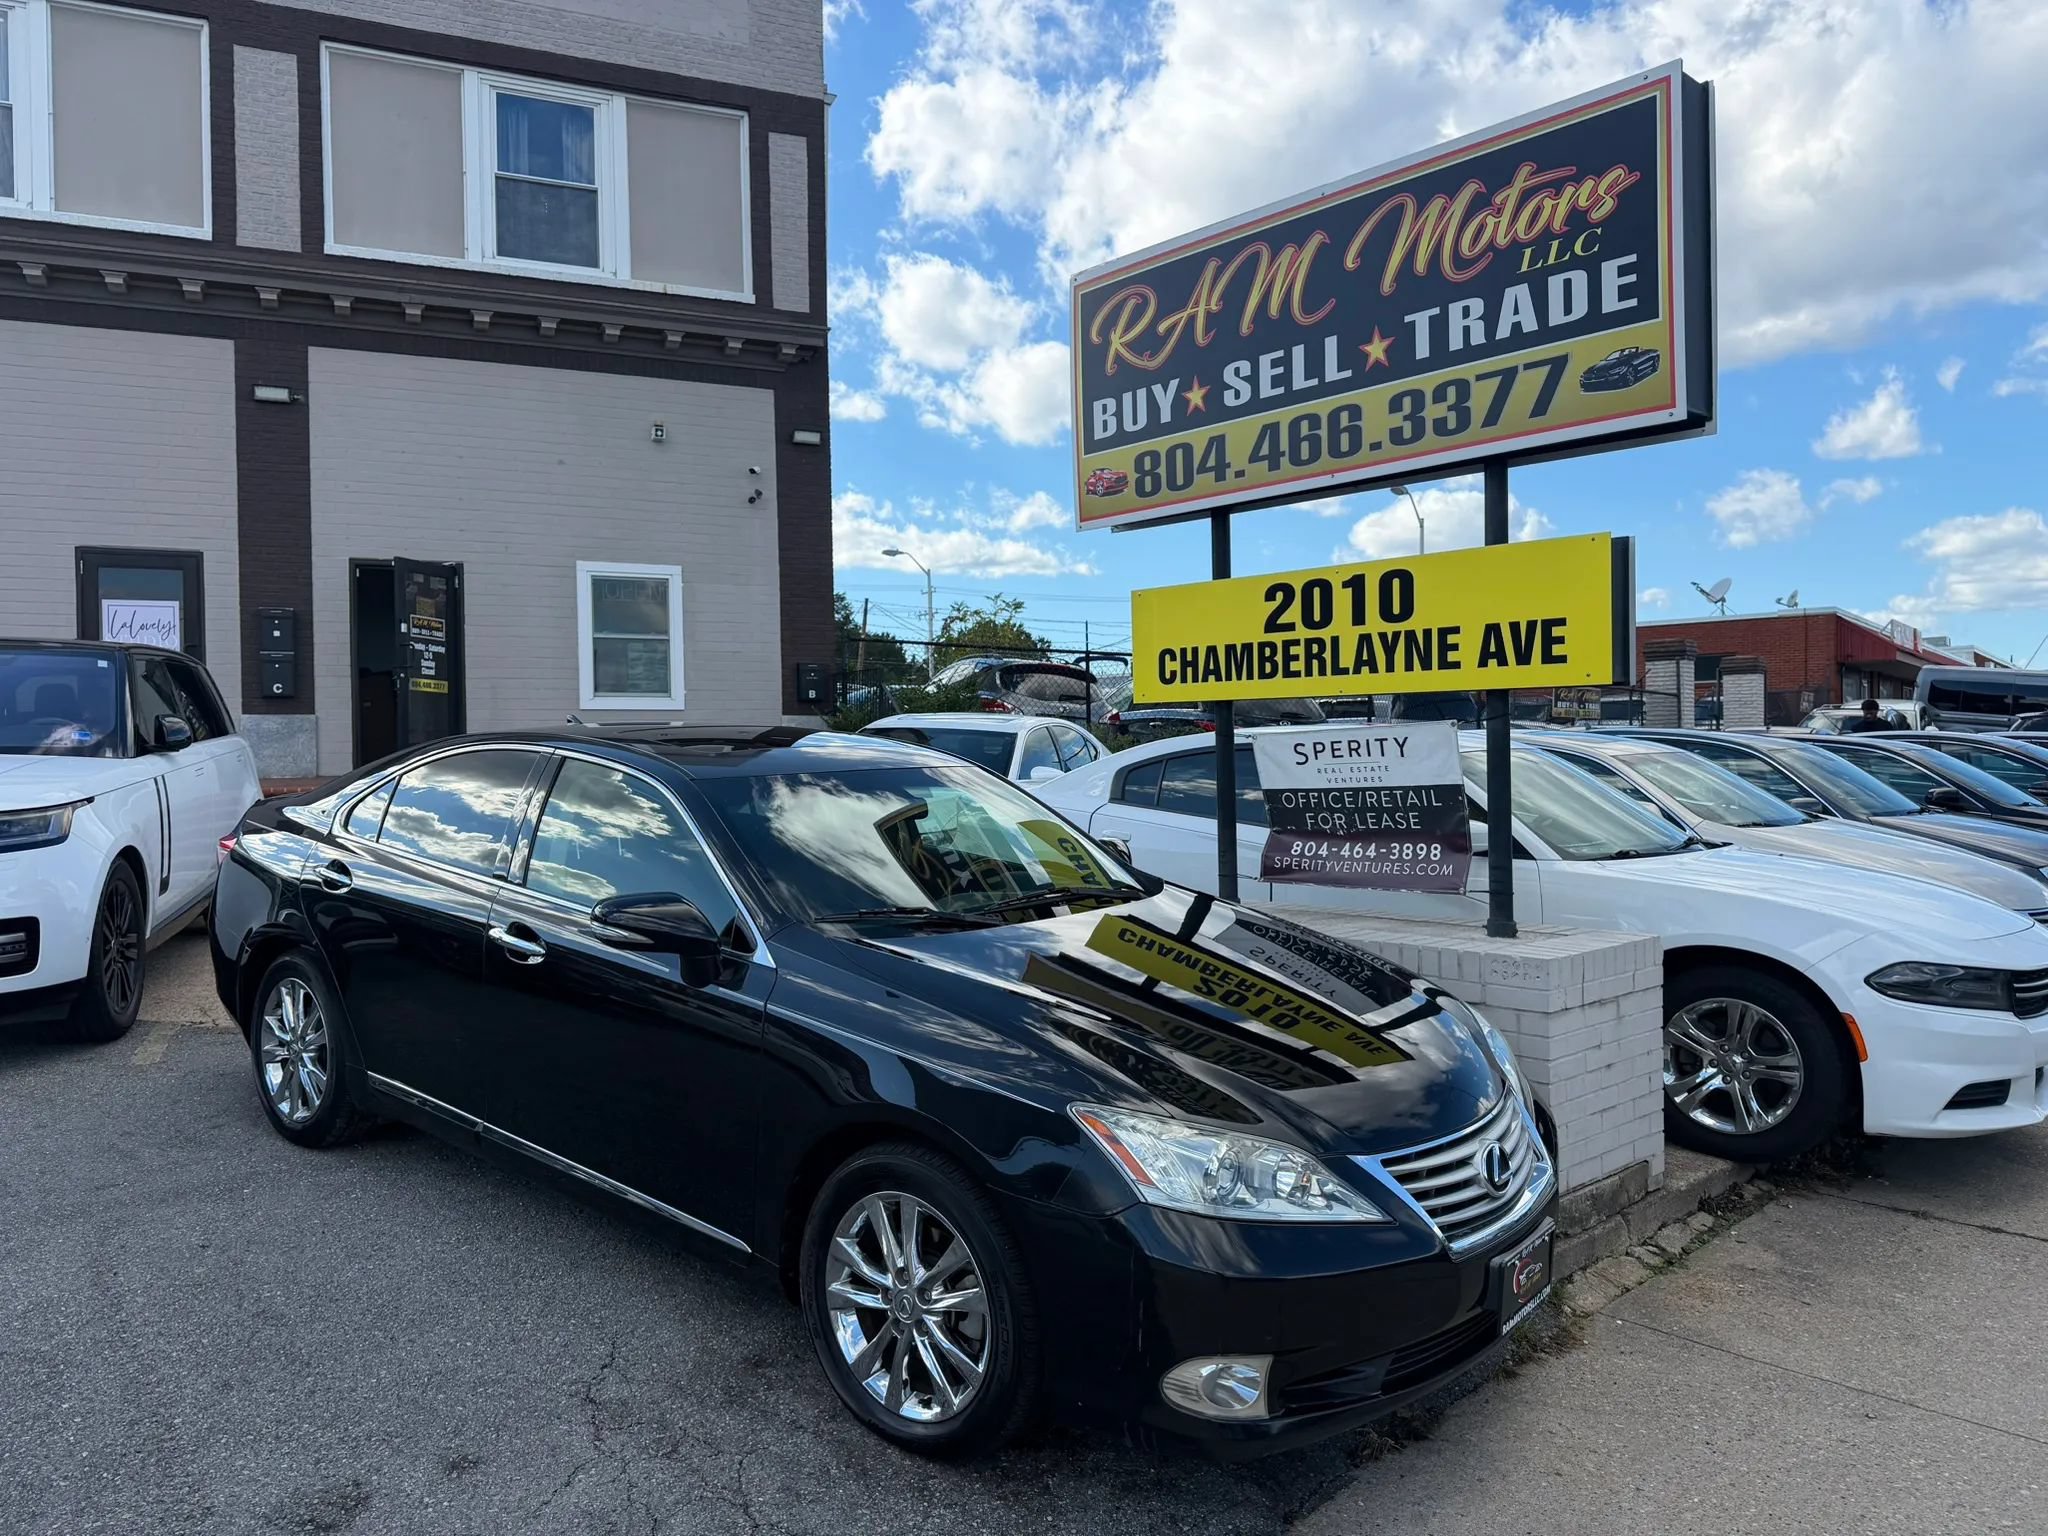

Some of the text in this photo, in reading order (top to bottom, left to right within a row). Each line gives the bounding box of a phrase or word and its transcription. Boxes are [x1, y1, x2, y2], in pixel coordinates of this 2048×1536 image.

[1516, 227, 1602, 274] LLC
[1089, 162, 1640, 376] RAM Motors
[1093, 254, 1638, 440] BUY SELL TRADE
[1133, 352, 1572, 499] 804.466.3377
[1263, 568, 1415, 634] 2010
[1157, 617, 1568, 686] CHAMBERLAYNE AVE
[272, 683, 283, 694] C
[808, 689, 816, 699] B
[1293, 736, 1409, 765] SPERITY
[1316, 765, 1391, 775] REAL ESTATE
[1326, 776, 1384, 784] VENTURES
[1281, 789, 1443, 808] OFFICE/RETAIL
[1305, 812, 1422, 829] FOR LEASE
[1290, 841, 1442, 861] 804-464-3898
[1273, 856, 1454, 876] SPERITYVENTURES.COM
